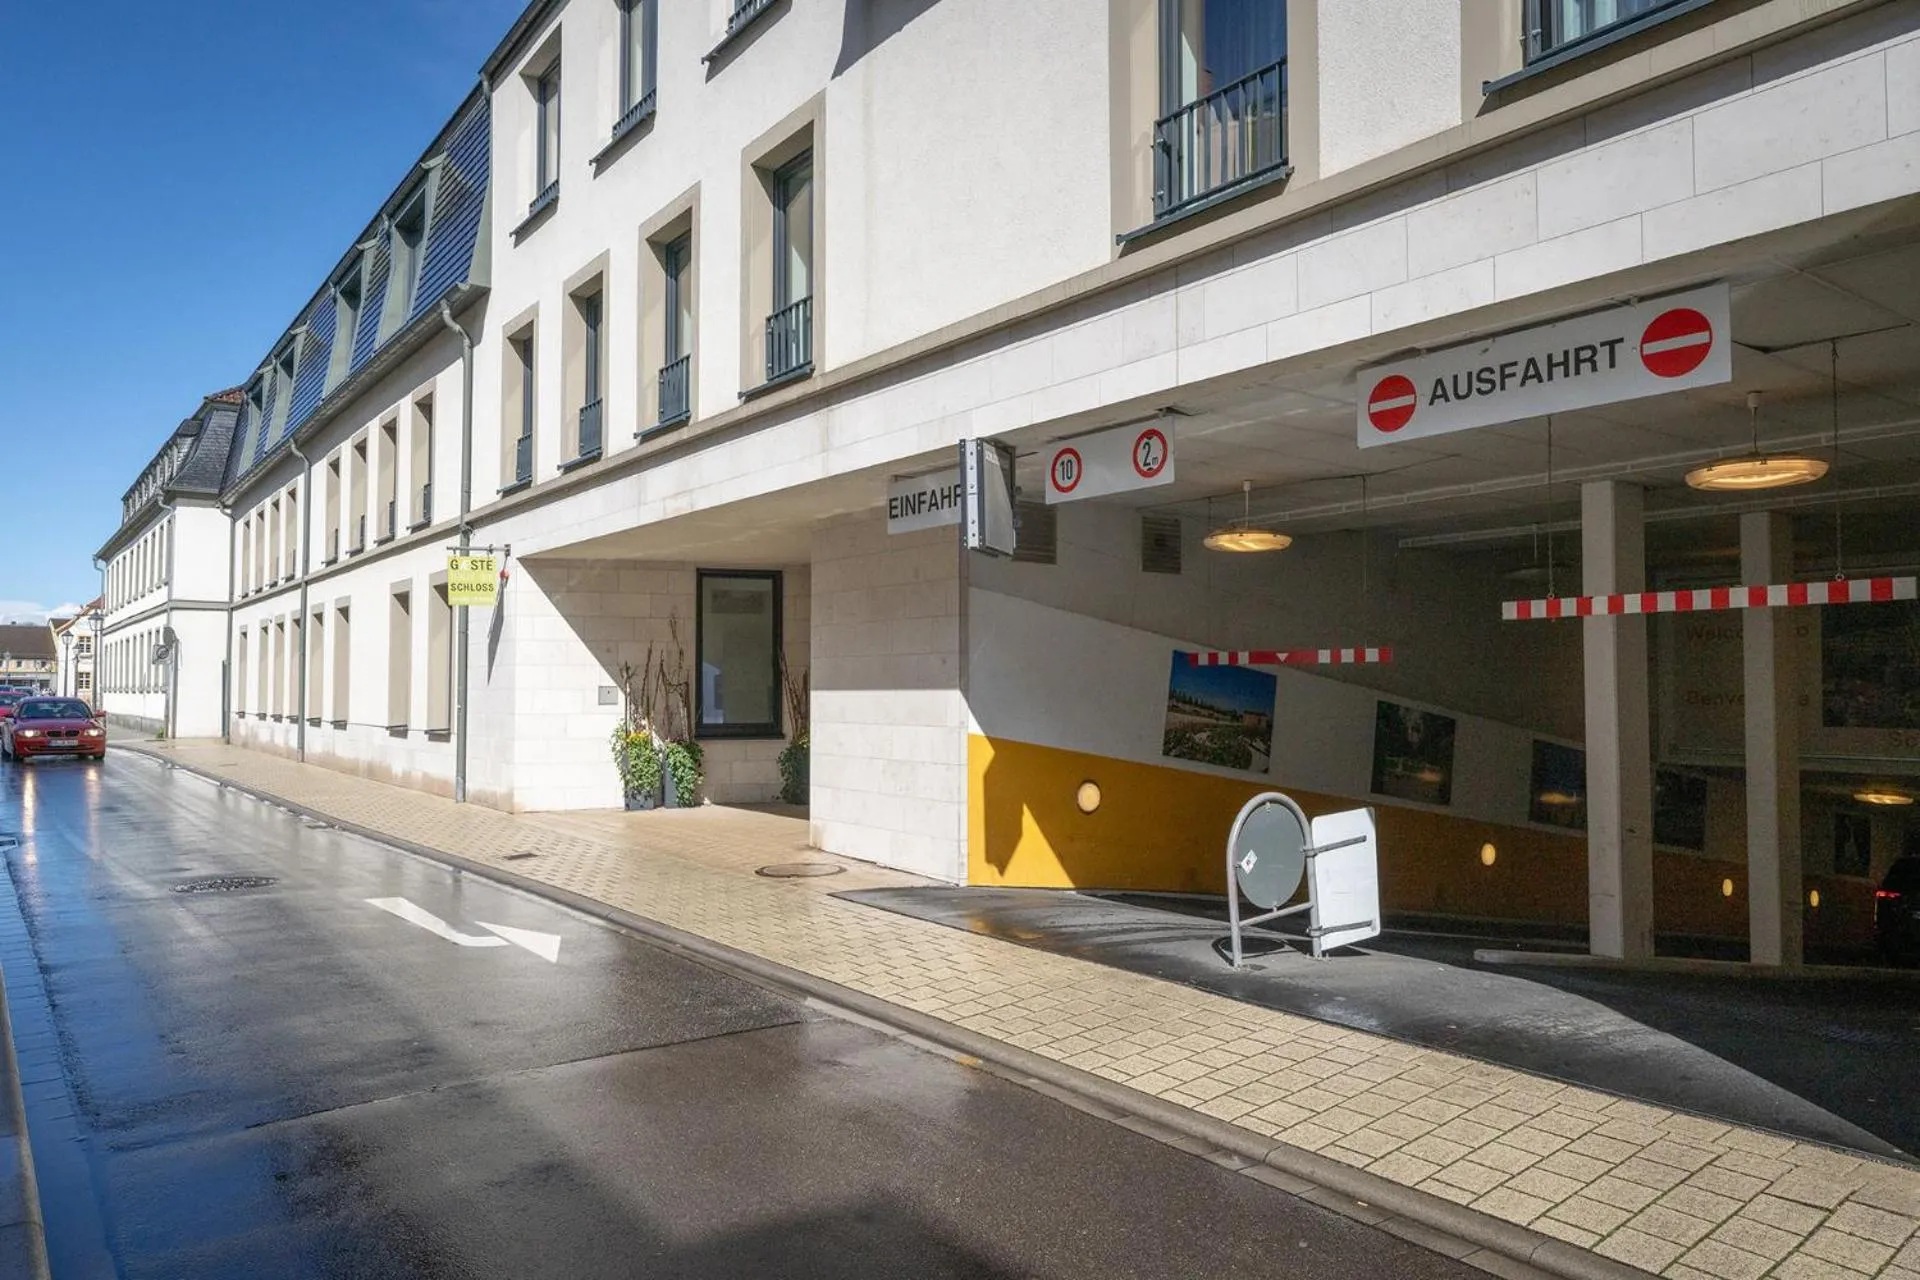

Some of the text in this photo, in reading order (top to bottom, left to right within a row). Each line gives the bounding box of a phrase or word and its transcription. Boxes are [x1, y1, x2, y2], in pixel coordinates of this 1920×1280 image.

[1428, 337, 1625, 406] AUSFAHRT
[1058, 458, 1073, 481] 10
[889, 484, 961, 520] EINFAHR
[450, 559, 493, 570] GSTE
[450, 583, 494, 592] SCHLOSS
